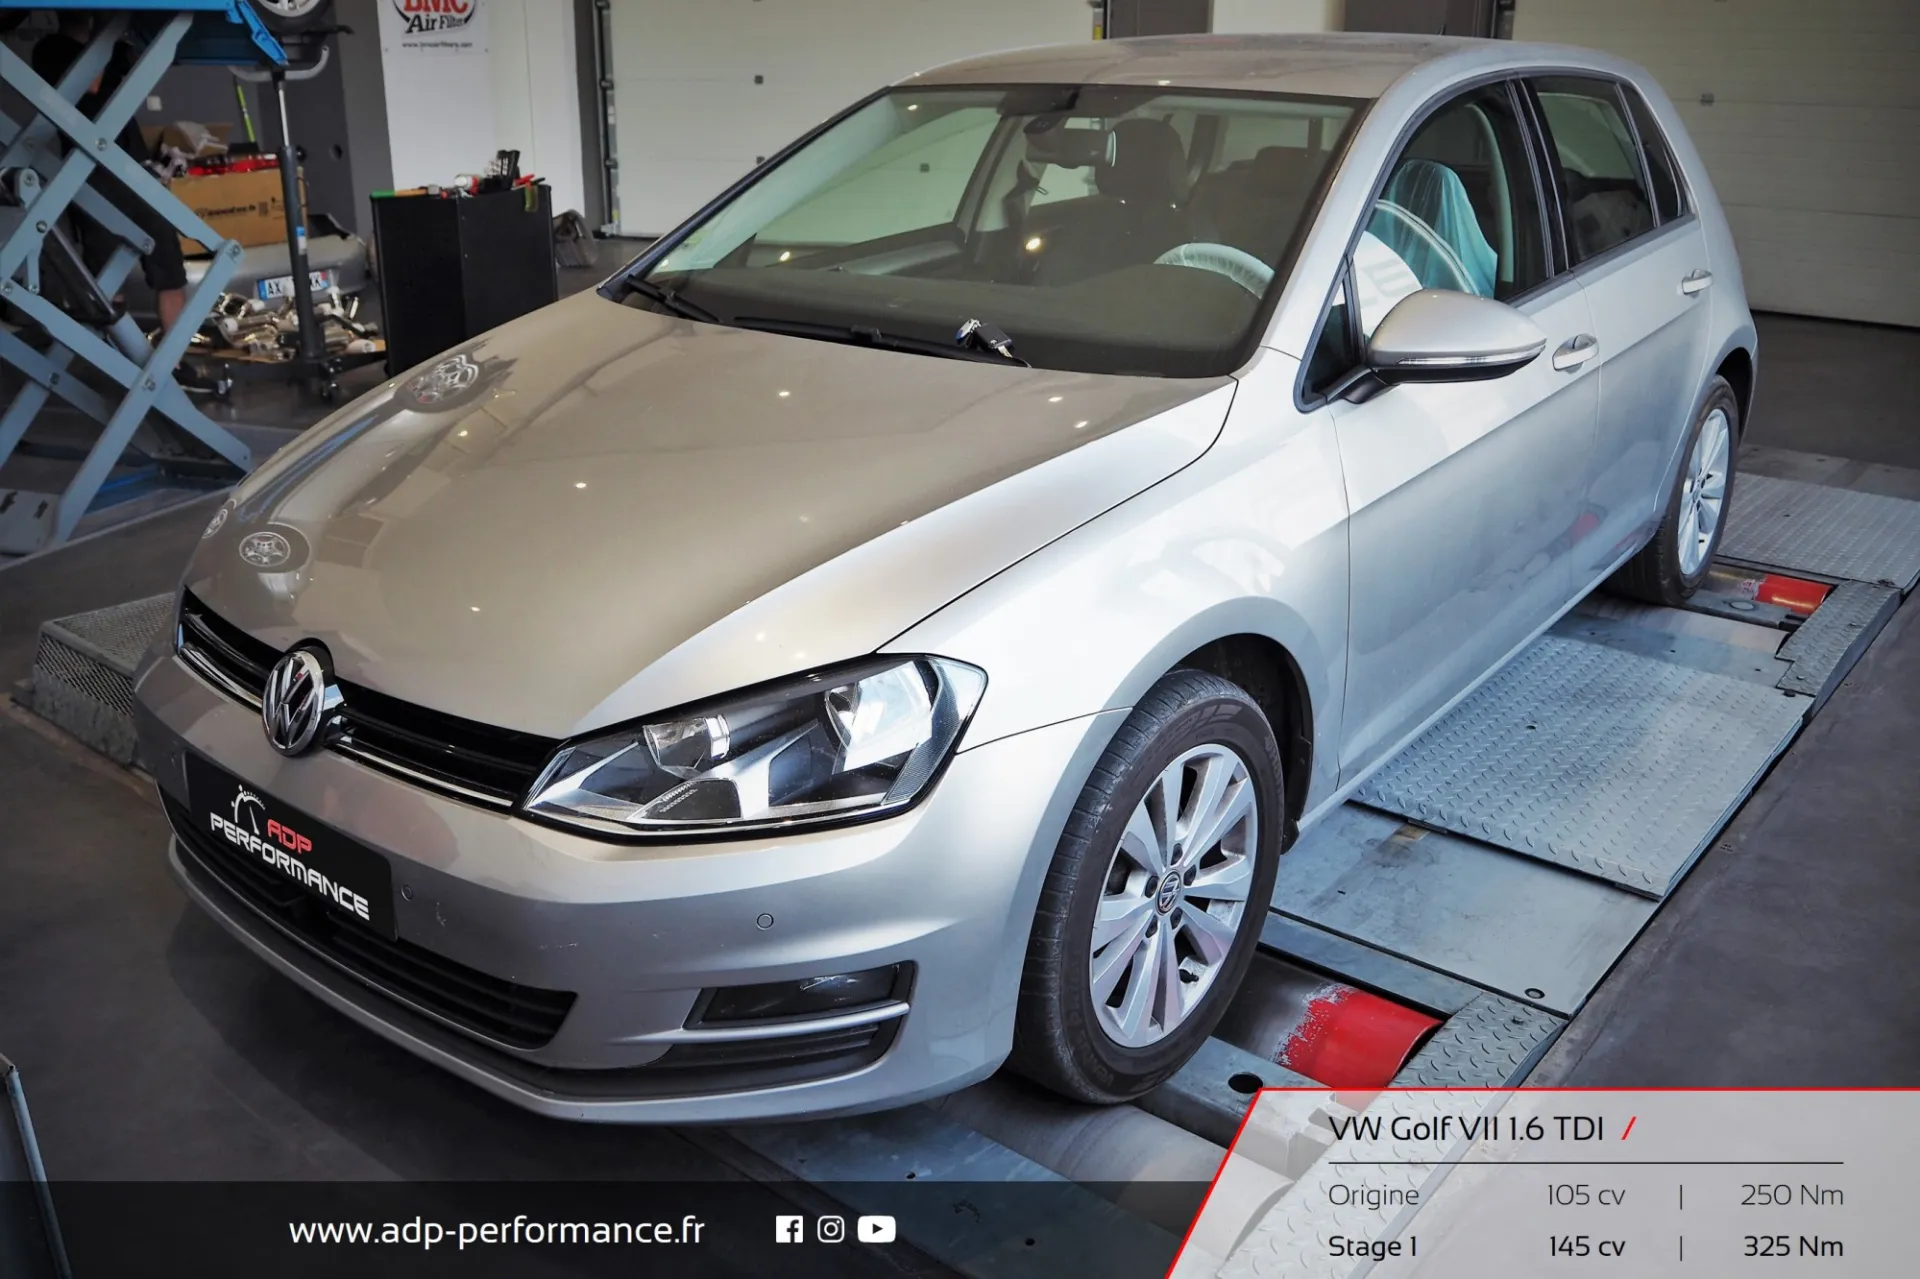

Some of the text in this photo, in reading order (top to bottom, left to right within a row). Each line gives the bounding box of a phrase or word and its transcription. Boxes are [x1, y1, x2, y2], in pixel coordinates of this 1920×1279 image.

[405, 13, 438, 34] Air
[267, 818, 312, 854] ADP
[210, 812, 370, 921] PERFORMANCE
